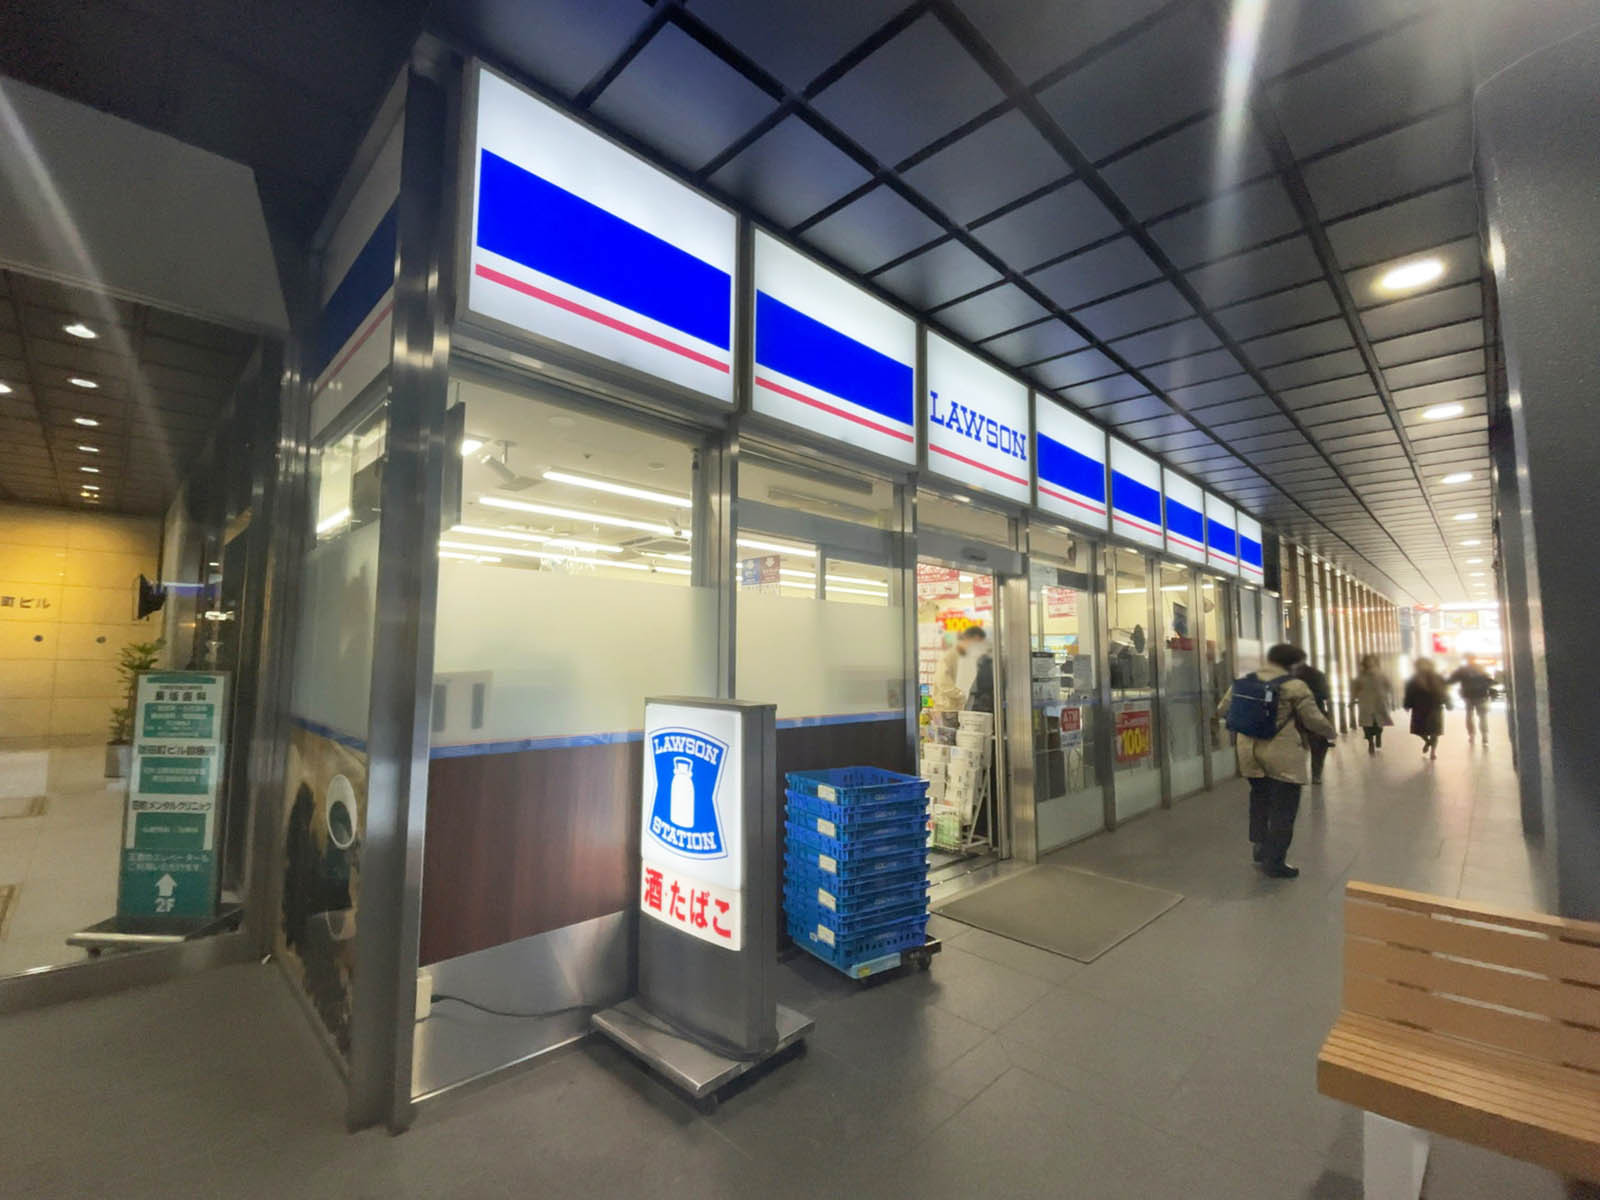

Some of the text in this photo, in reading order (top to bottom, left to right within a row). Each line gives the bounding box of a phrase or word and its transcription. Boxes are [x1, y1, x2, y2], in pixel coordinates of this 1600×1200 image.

[930, 390, 1027, 461] LAWSON
[654, 736, 719, 765] LAWSON
[652, 816, 717, 850] STATION
[154, 898, 176, 912] 2F
